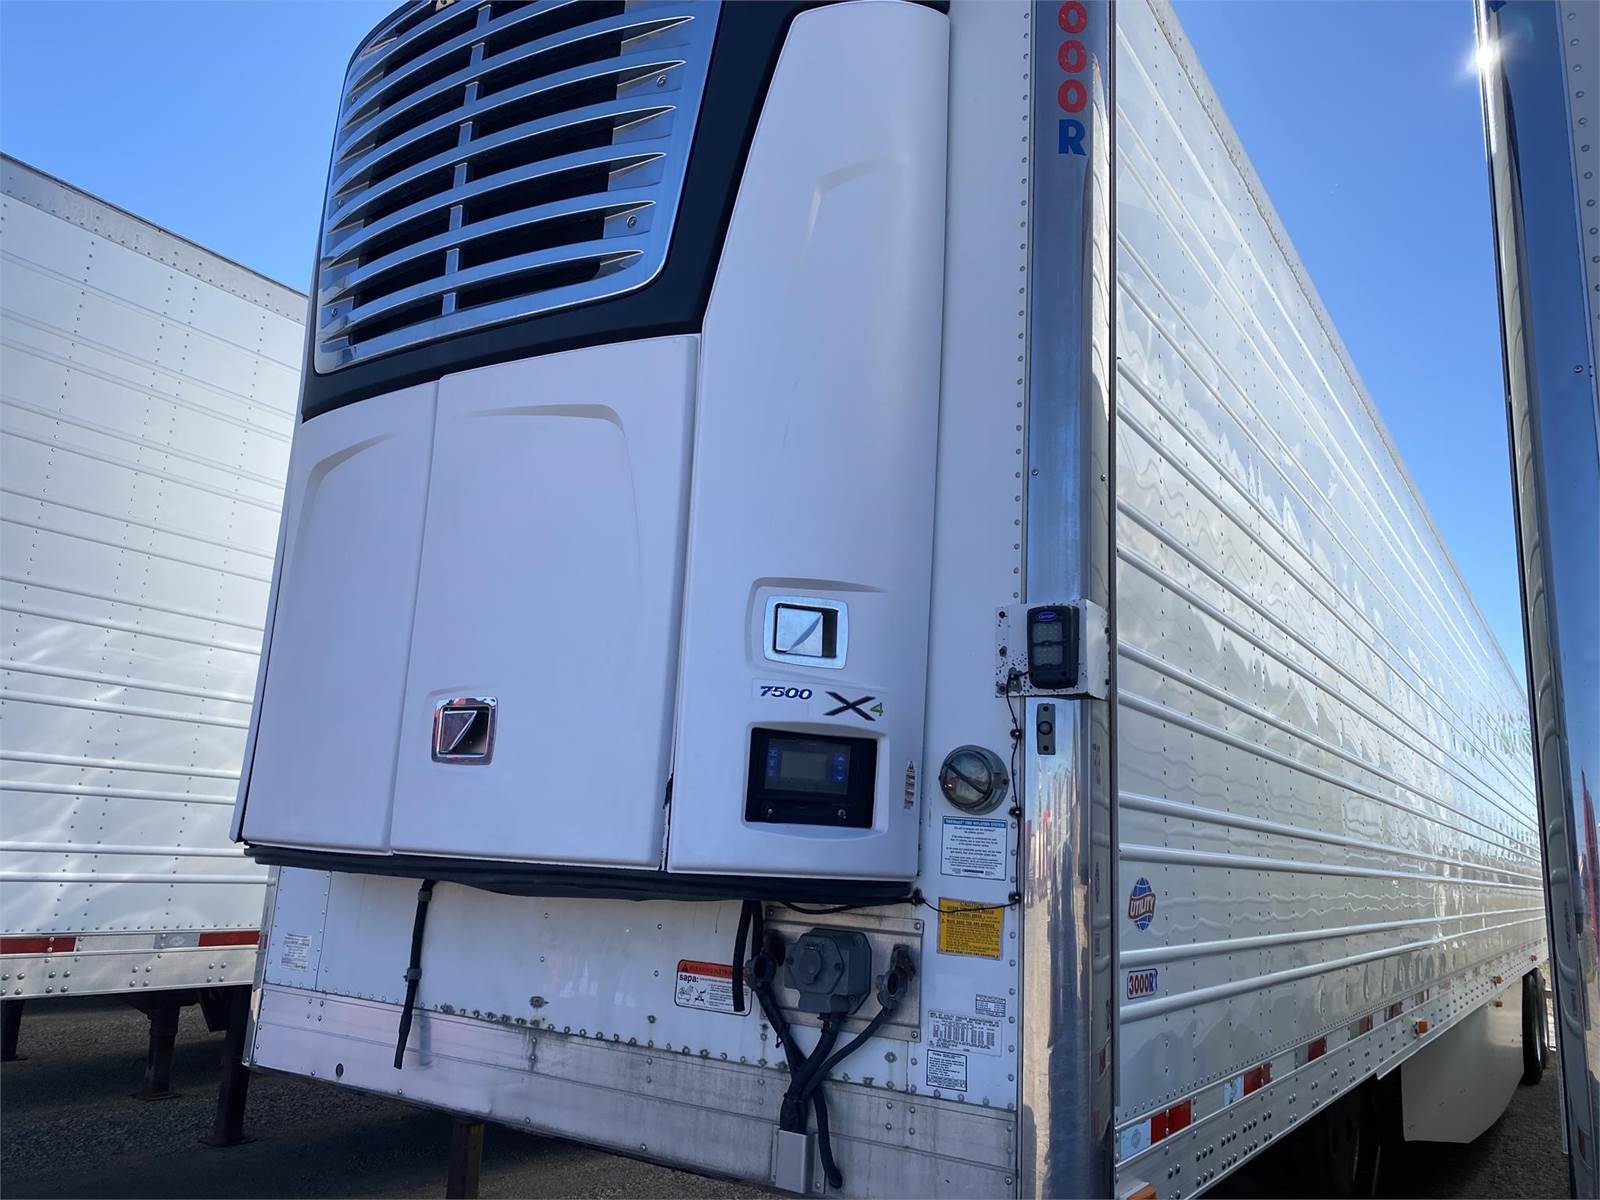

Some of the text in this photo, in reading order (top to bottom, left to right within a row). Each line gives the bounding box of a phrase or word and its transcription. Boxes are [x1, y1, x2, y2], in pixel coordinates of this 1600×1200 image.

[760, 686, 813, 700] 7500
[1129, 896, 1156, 918] UTILITY
[1128, 972, 1155, 995] 3000R
